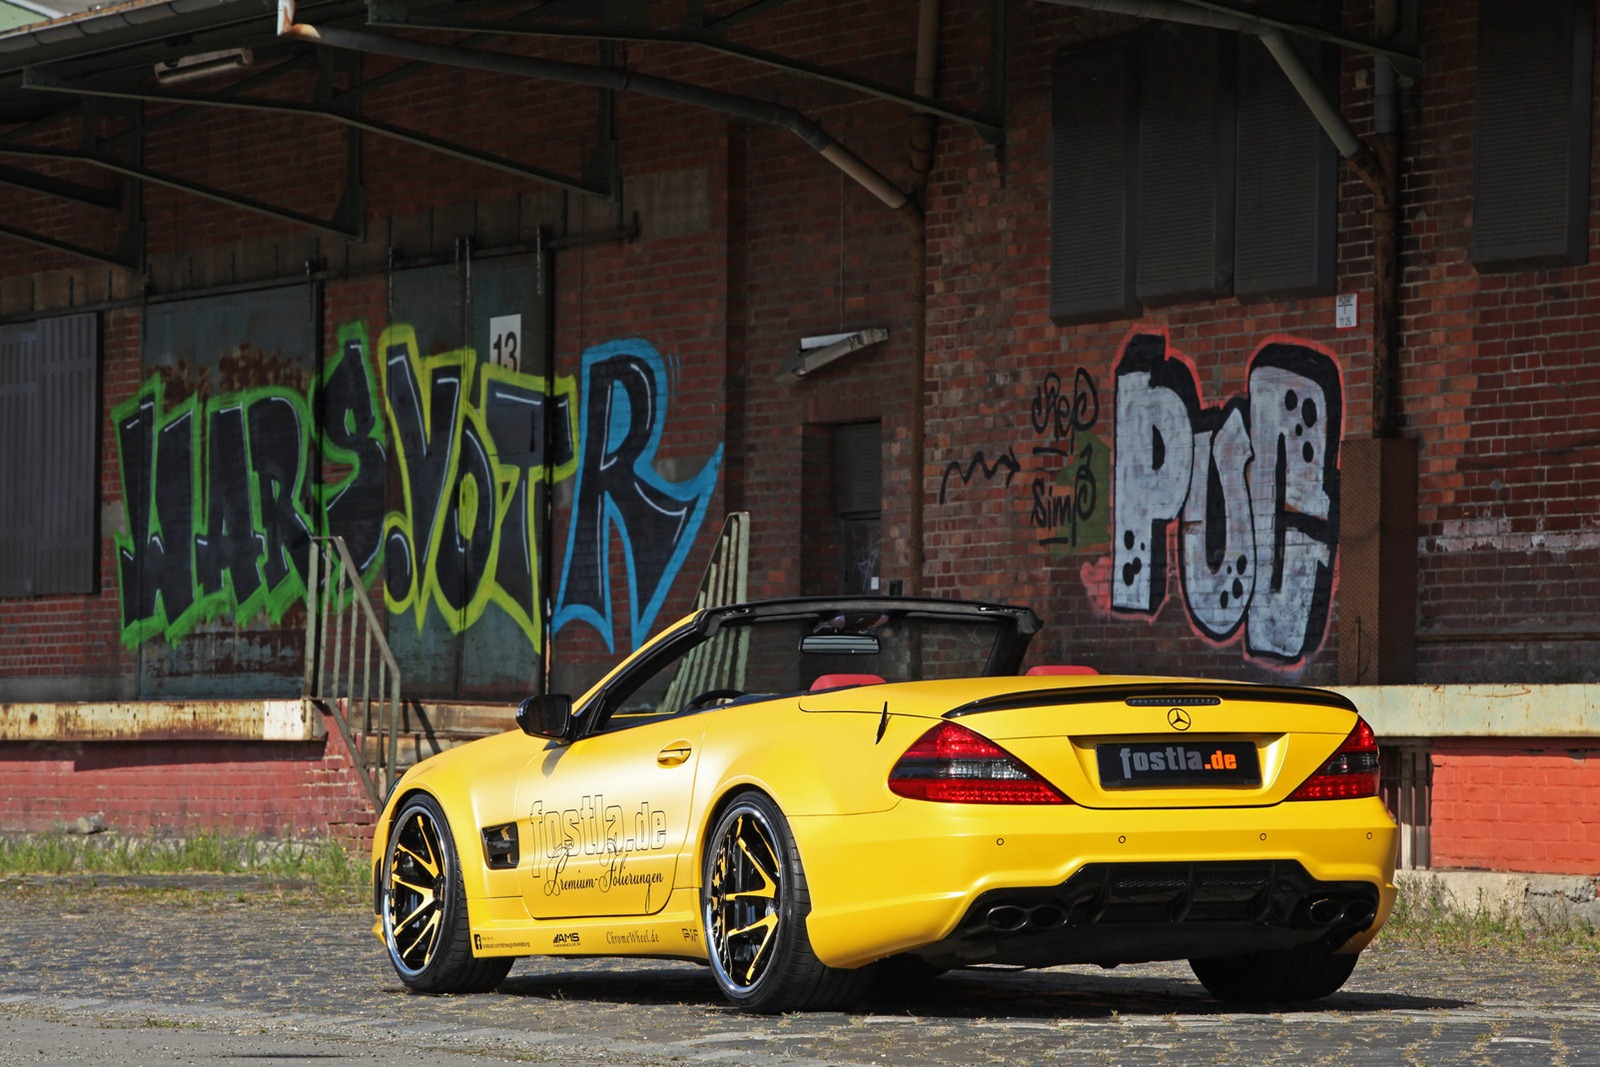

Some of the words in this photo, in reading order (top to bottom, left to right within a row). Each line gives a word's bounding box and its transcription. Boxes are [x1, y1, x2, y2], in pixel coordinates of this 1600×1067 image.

[493, 331, 517, 372] 13
[1119, 746, 1238, 779] fostla.de
[529, 794, 667, 879] fostla.de
[552, 932, 580, 944] AMS
[605, 929, 660, 945] ChromeWheel.de
